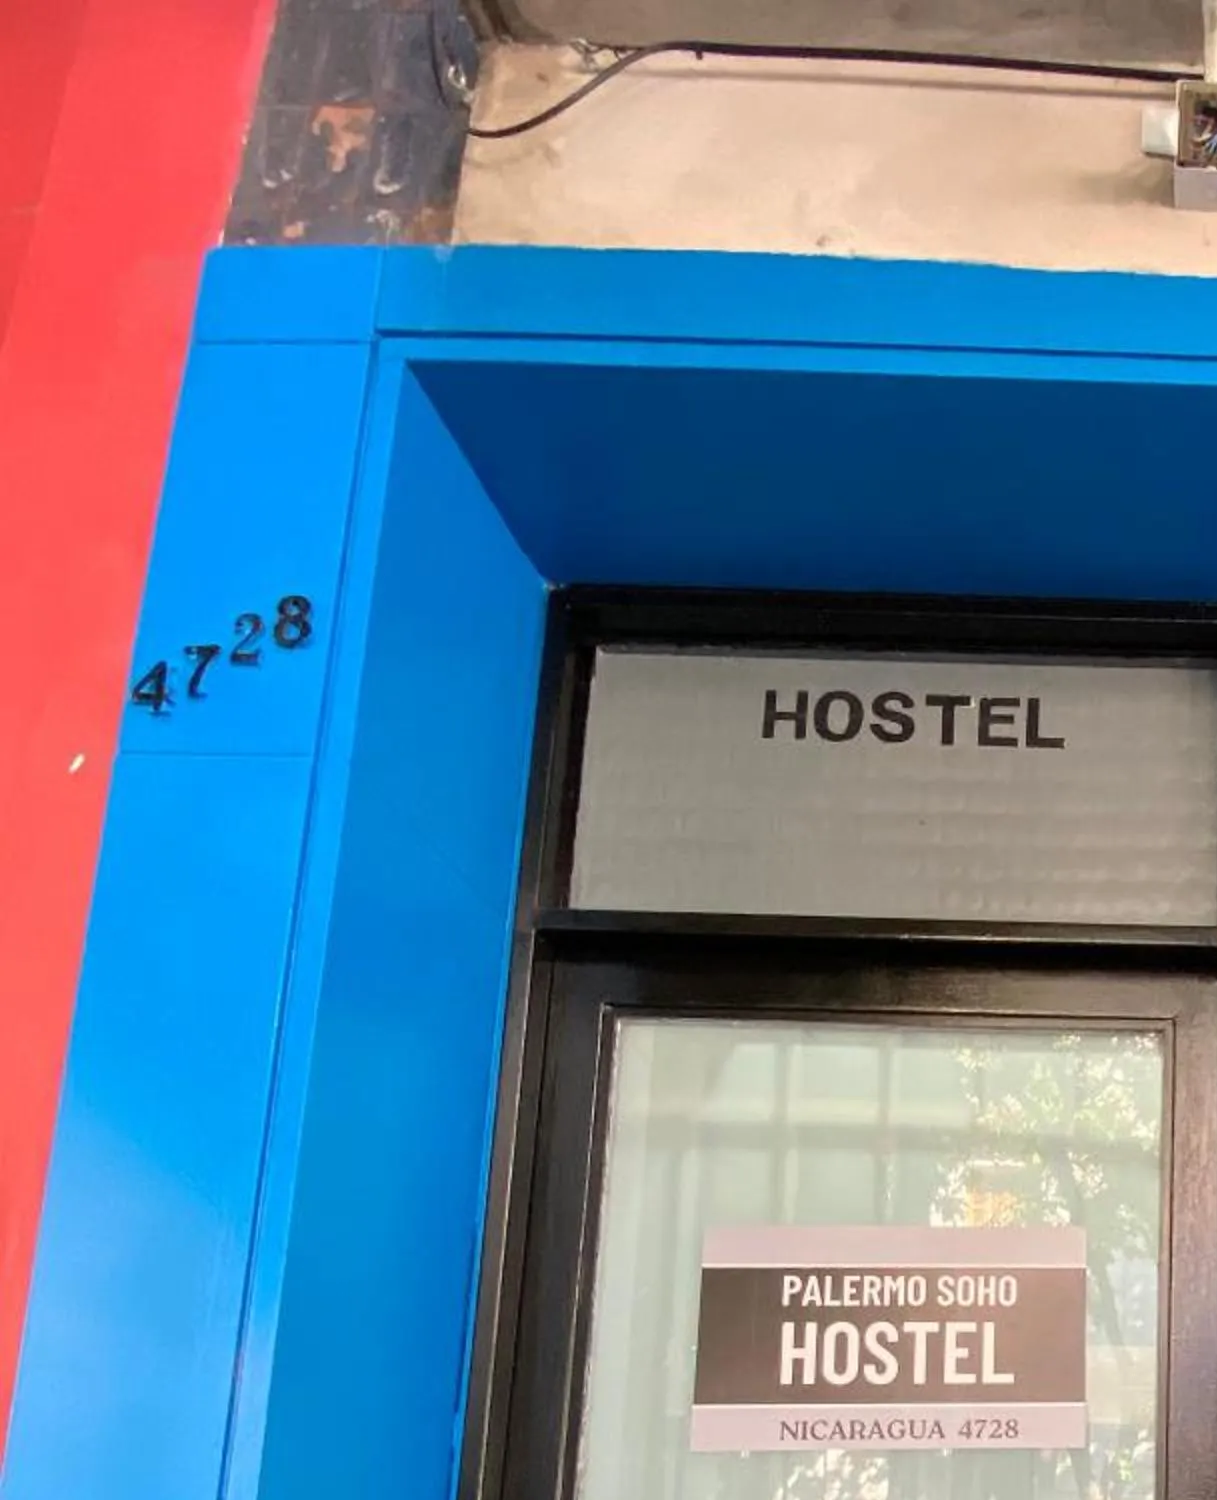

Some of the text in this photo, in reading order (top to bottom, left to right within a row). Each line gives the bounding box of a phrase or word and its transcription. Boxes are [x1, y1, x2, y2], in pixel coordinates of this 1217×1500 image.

[132, 595, 313, 715] 4728
[761, 690, 1066, 749] HOSTEL
[781, 1275, 1018, 1307] PALERMO SOHO
[778, 1320, 1015, 1386] HOSTEL
[778, 1418, 1020, 1441] NICARAGUA 4728
